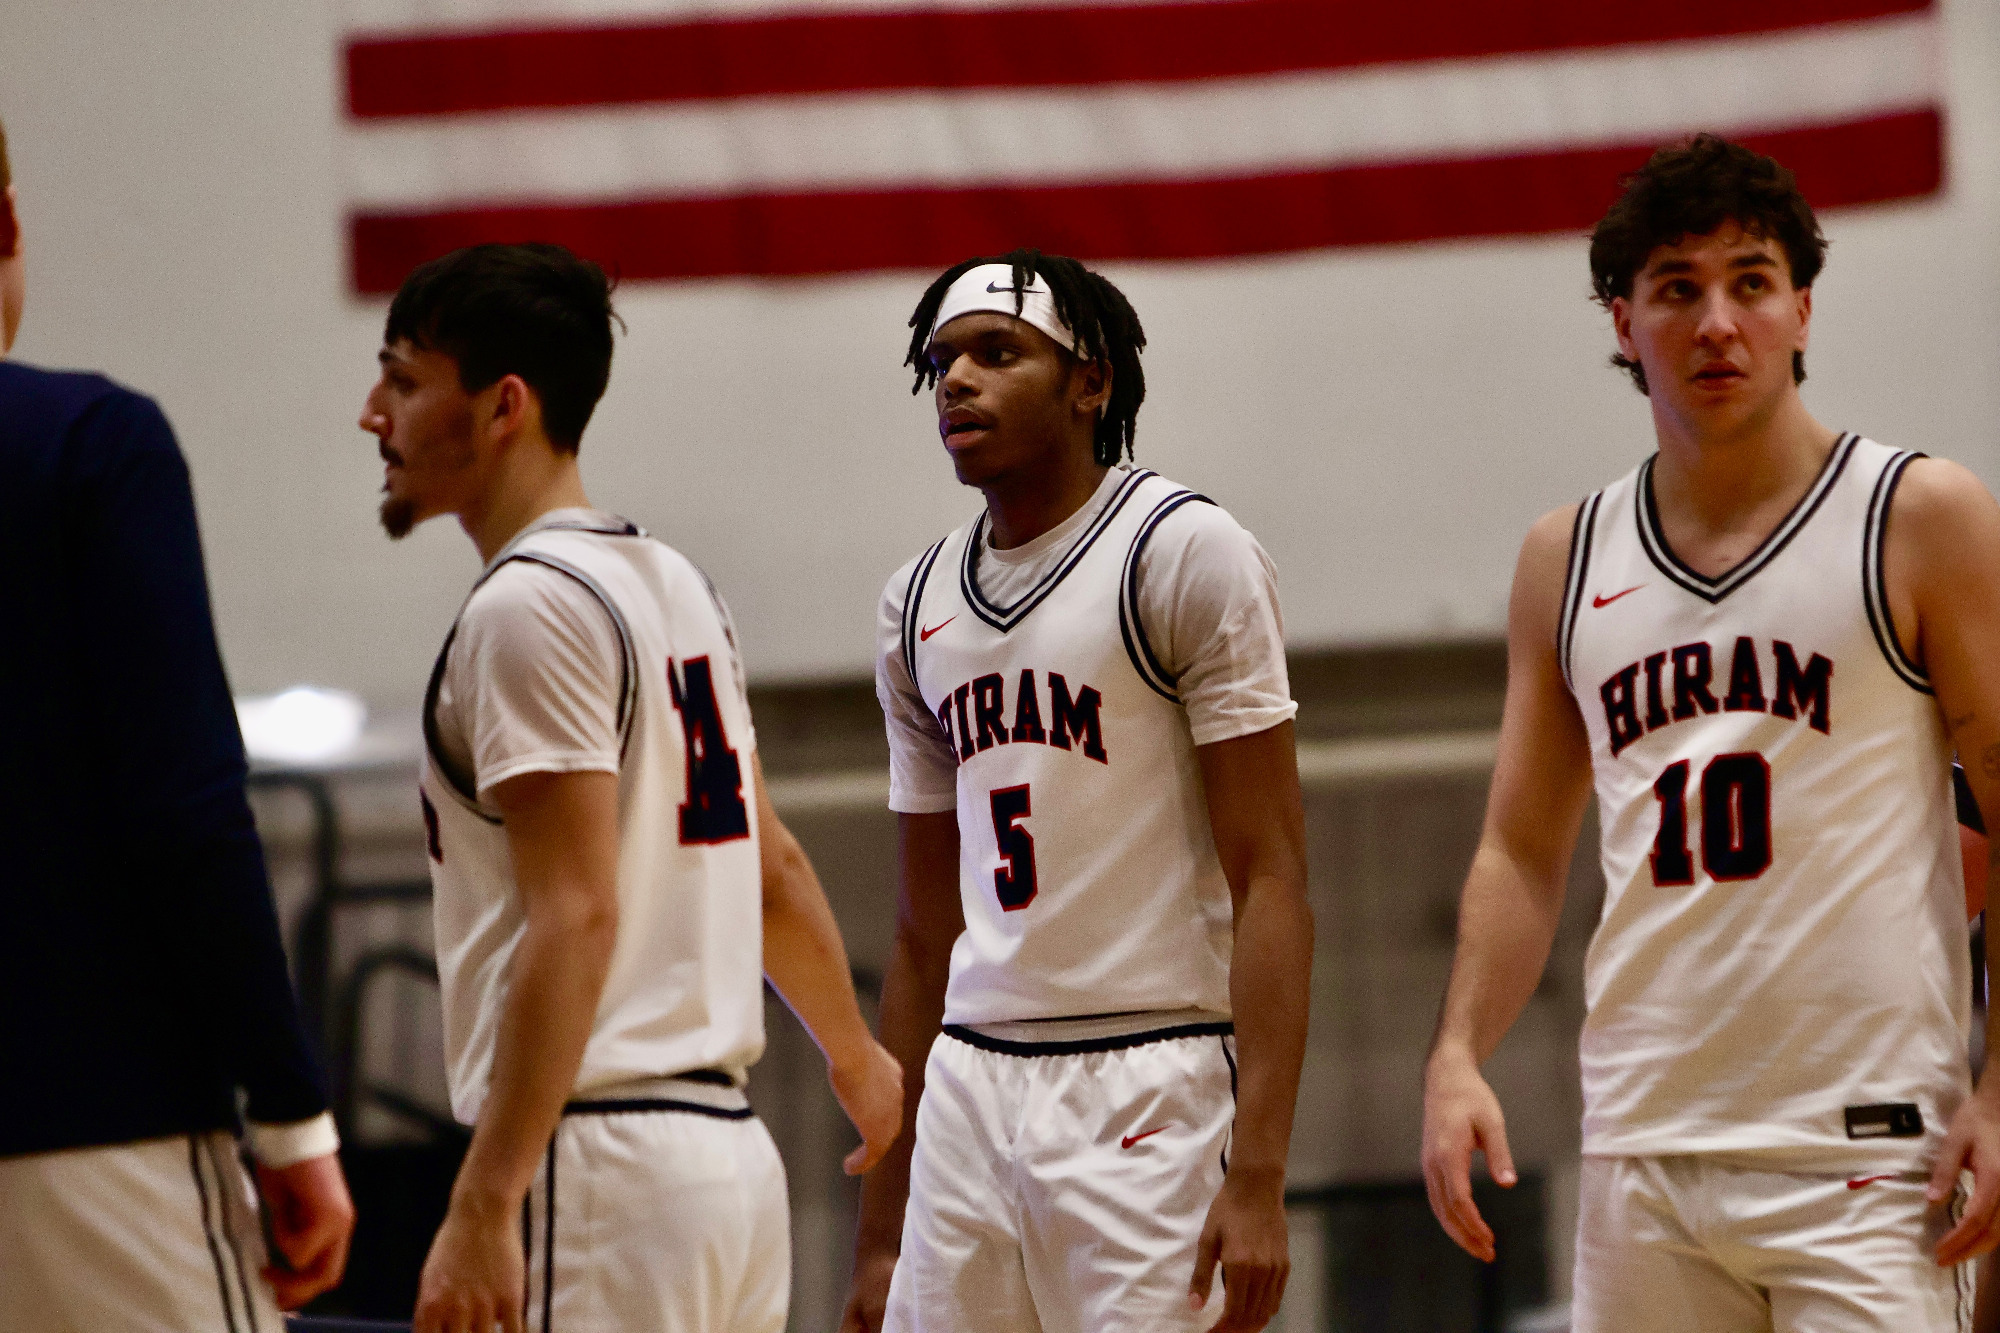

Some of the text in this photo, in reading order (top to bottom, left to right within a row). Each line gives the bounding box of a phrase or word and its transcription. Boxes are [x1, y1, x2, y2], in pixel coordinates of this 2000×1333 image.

[937, 668, 1109, 767] HIRAM
[1600, 636, 1833, 759] HIRAM
[989, 783, 1038, 912] 5
[1650, 751, 1773, 887] 10
